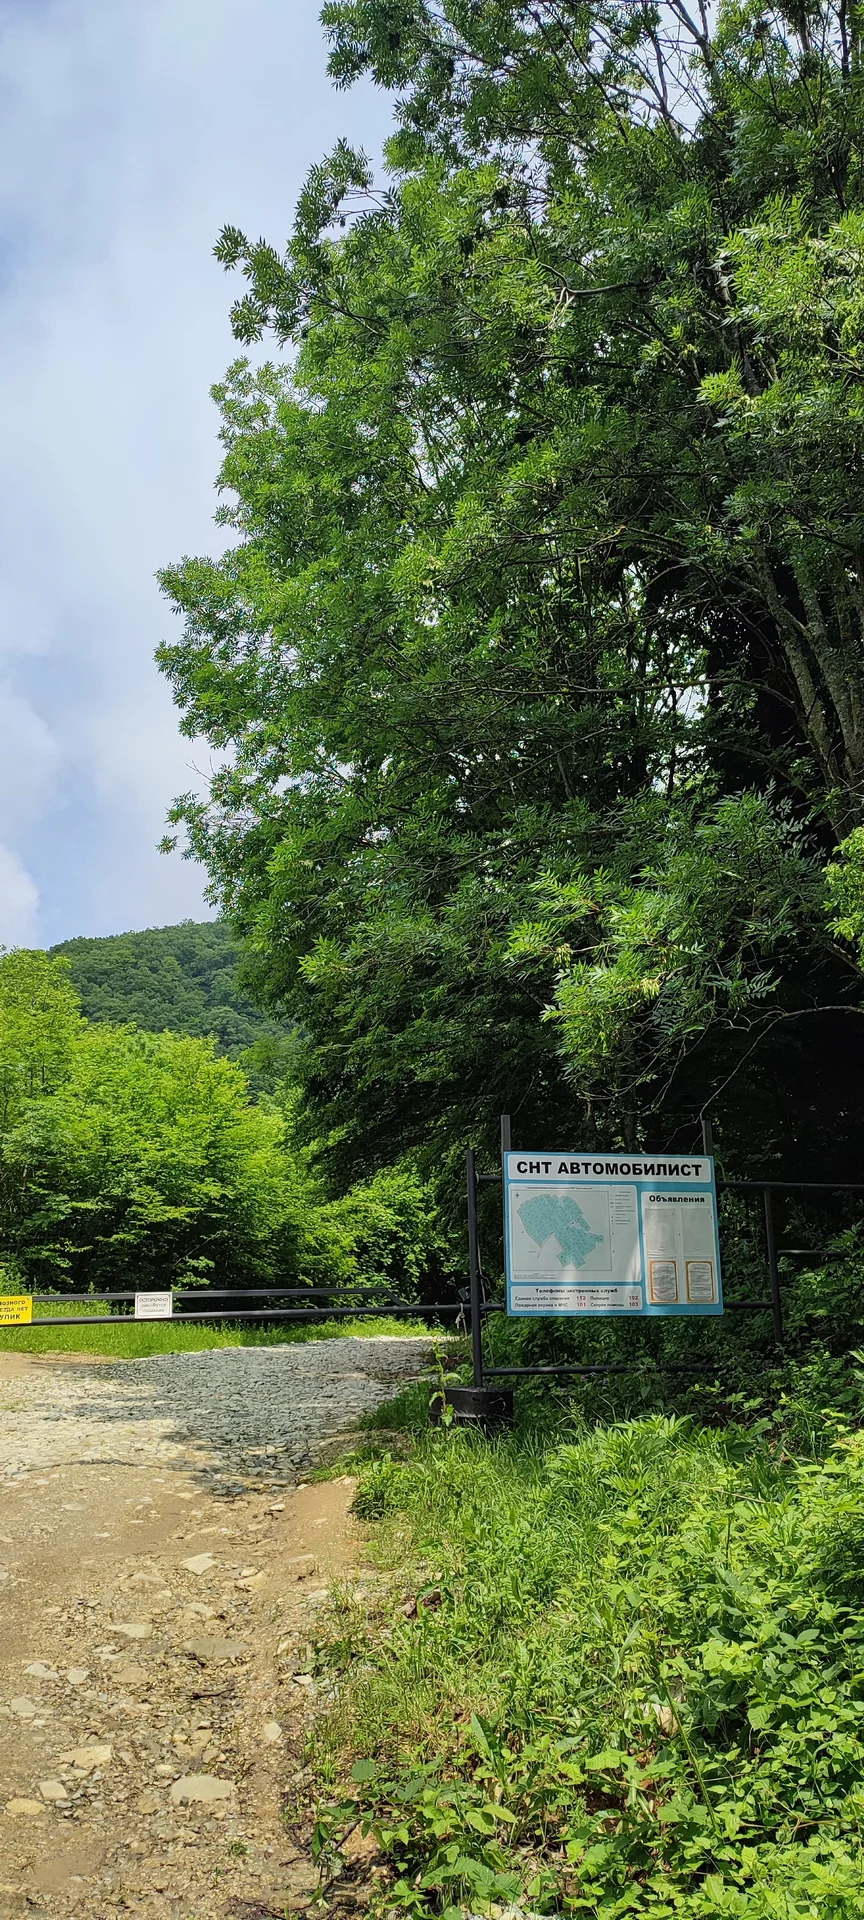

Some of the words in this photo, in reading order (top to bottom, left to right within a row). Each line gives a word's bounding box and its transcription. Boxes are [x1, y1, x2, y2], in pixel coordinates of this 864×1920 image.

[516, 1161, 552, 1174] СНТ
[557, 1162, 702, 1176] АВТОМОБИЛИСТ
[649, 1195, 705, 1203] Объявления
